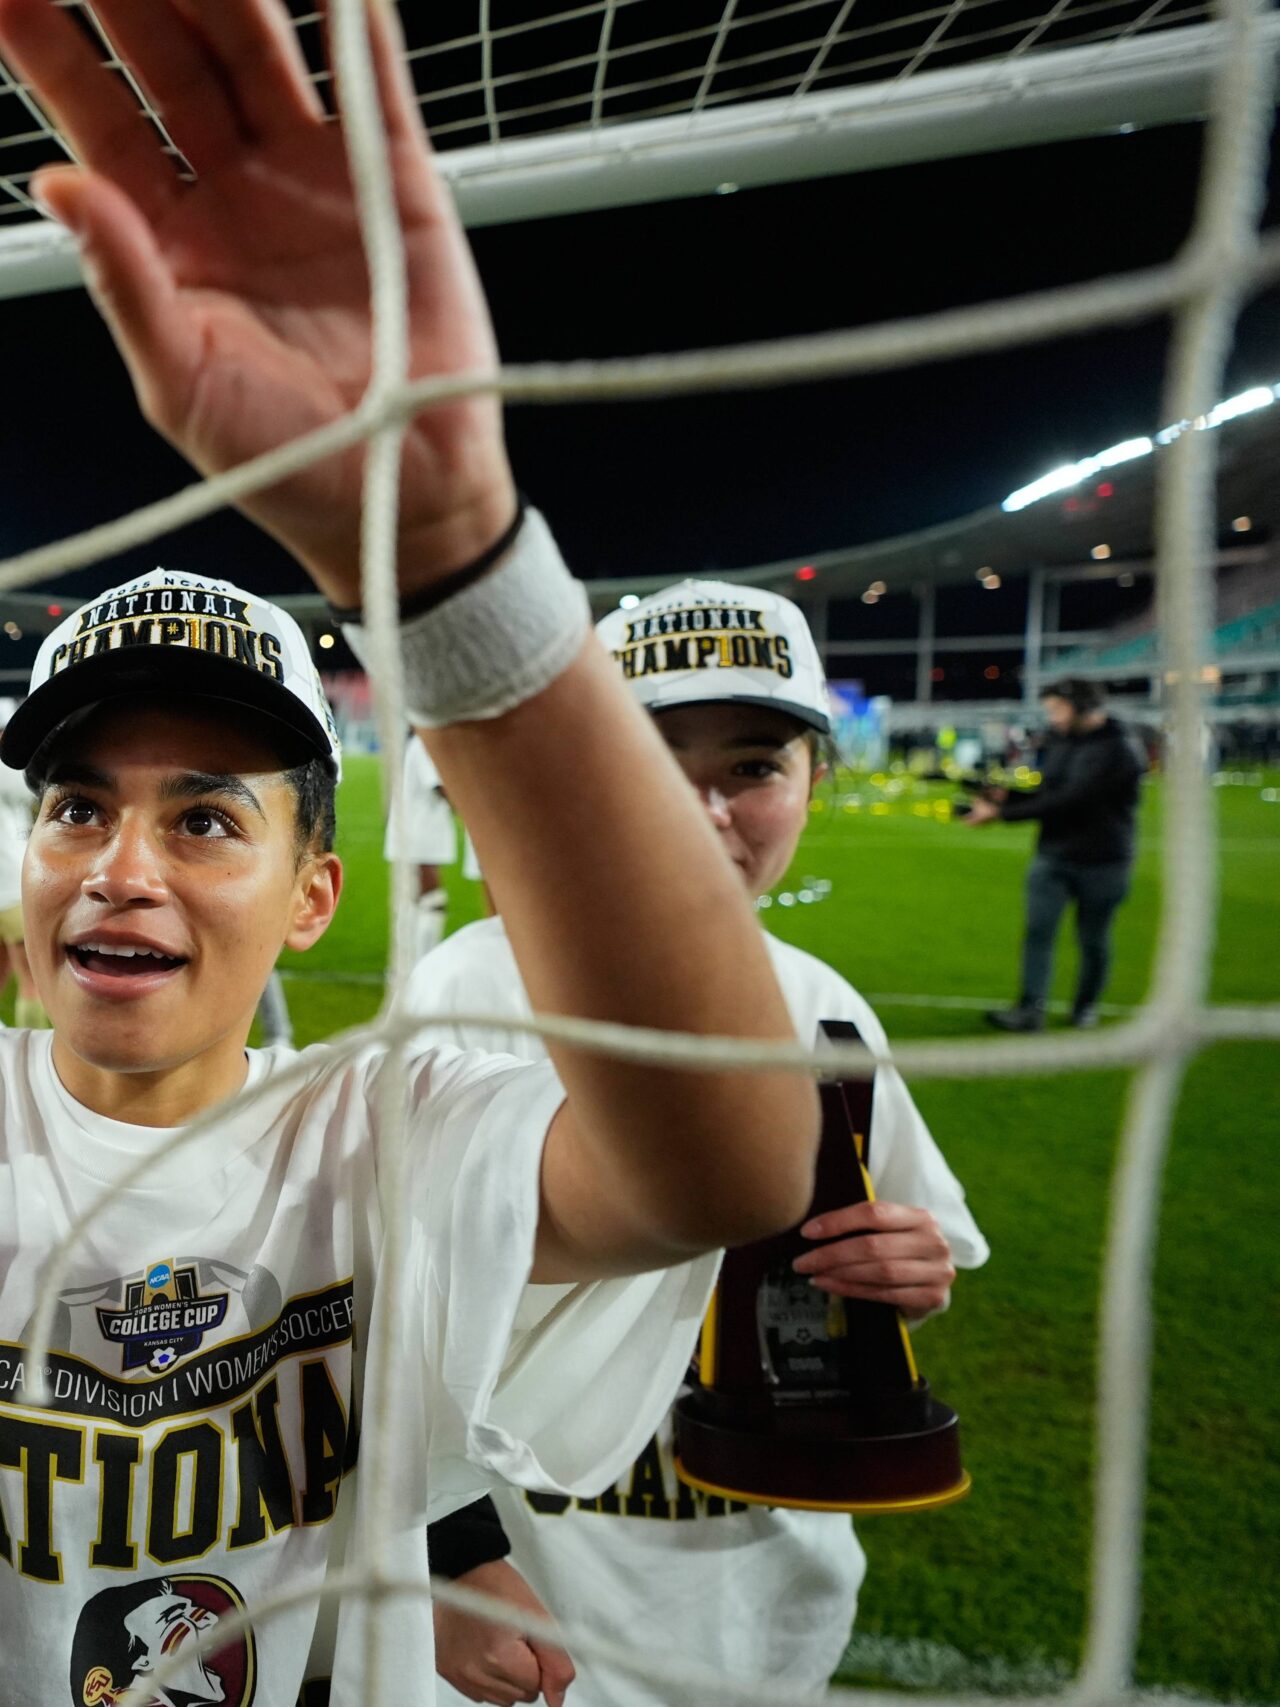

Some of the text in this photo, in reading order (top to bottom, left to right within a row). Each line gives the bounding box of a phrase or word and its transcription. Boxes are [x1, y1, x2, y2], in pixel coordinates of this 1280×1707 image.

[105, 580, 151, 600] 2025
[86, 590, 238, 628] NATIONAL
[631, 609, 756, 640] NATIONAL
[149, 1273, 171, 1285] NCAA
[134, 1301, 189, 1315] 2025 WOMEN'S
[109, 1304, 219, 1336] COLLEGE CUP
[143, 1336, 184, 1347] KANSAS CITY
[85, 1673, 111, 1698] FSU
